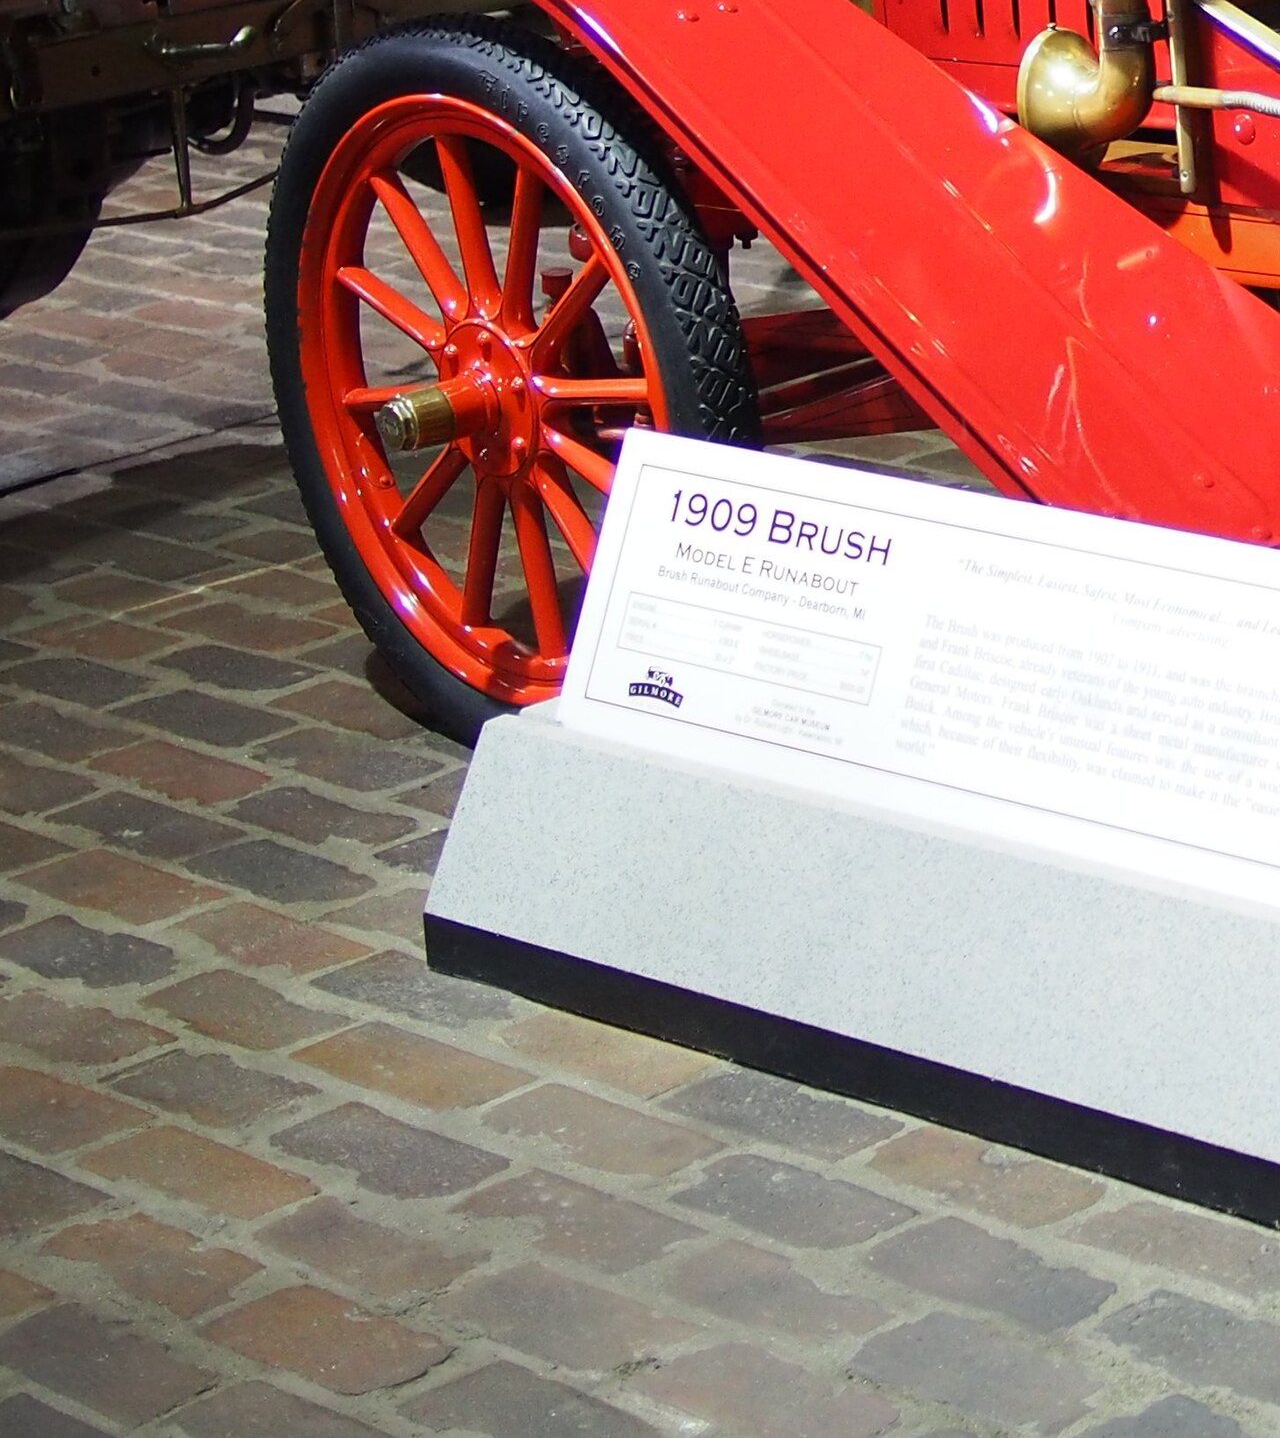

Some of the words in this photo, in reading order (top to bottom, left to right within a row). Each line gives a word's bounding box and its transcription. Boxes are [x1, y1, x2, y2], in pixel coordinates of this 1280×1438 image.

[478, 69, 642, 281] Firestone
[671, 490, 757, 536] 1909
[768, 509, 891, 564] BRUSH
[657, 564, 688, 581] Brush
[689, 571, 739, 593] Runabout
[741, 583, 789, 606] Company
[798, 595, 849, 619] Dearborn,
[852, 606, 866, 619] MI
[675, 541, 735, 571] MODEL
[741, 555, 756, 574] E
[759, 559, 858, 595] RUNABOUT
[1122, 591, 1151, 609] Most
[1235, 618, 1261, 634] and
[917, 636, 939, 651] and
[940, 638, 969, 658] Frank
[1017, 657, 1057, 680] already
[1061, 668, 1105, 689] veterans
[1107, 676, 1123, 692] of
[1122, 678, 1140, 696] the
[1141, 685, 1177, 707] young
[1179, 694, 1205, 711] auto
[924, 613, 945, 630] The
[946, 618, 978, 638] Brush
[982, 629, 1002, 643] was
[1004, 634, 1055, 654] produced
[1057, 642, 1084, 661] from
[1116, 657, 1129, 671] to
[1164, 669, 1187, 683] and
[1189, 675, 1212, 688] was
[1213, 676, 1232, 693] the
[629, 683, 683, 708] GILMORE
[908, 674, 951, 696] General
[1000, 695, 1031, 715] Frank
[1037, 702, 1079, 726] Briscoe
[1084, 714, 1107, 732] was
[1108, 722, 1118, 735] a
[1121, 723, 1152, 742] sheet
[1157, 733, 1190, 750] metal
[1192, 742, 1268, 768] manufacturer
[912, 653, 936, 672] first
[988, 672, 1037, 694] designed
[1039, 685, 1067, 703] early
[1070, 688, 1122, 713] Oaklands
[1125, 703, 1148, 721] and
[1149, 709, 1189, 728] served
[1190, 718, 1205, 733] as
[1206, 722, 1216, 736] a
[1219, 725, 1279, 748] consultant
[937, 723, 979, 746] because
[981, 735, 998, 751] of
[997, 738, 1023, 757] their
[1085, 761, 1107, 776] was
[1111, 766, 1156, 788] claimed
[1158, 777, 1171, 792] to
[1173, 782, 1206, 800] make
[1209, 790, 1219, 802] it
[1221, 792, 1242, 809] the
[942, 704, 982, 728] Among
[985, 713, 1004, 730] the
[1058, 733, 1102, 753] unusual
[1105, 741, 1148, 764] features
[1154, 751, 1175, 770] was
[1179, 757, 1199, 778] the
[1202, 767, 1224, 782] use
[1226, 768, 1245, 785] of
[1244, 777, 1253, 789] a
